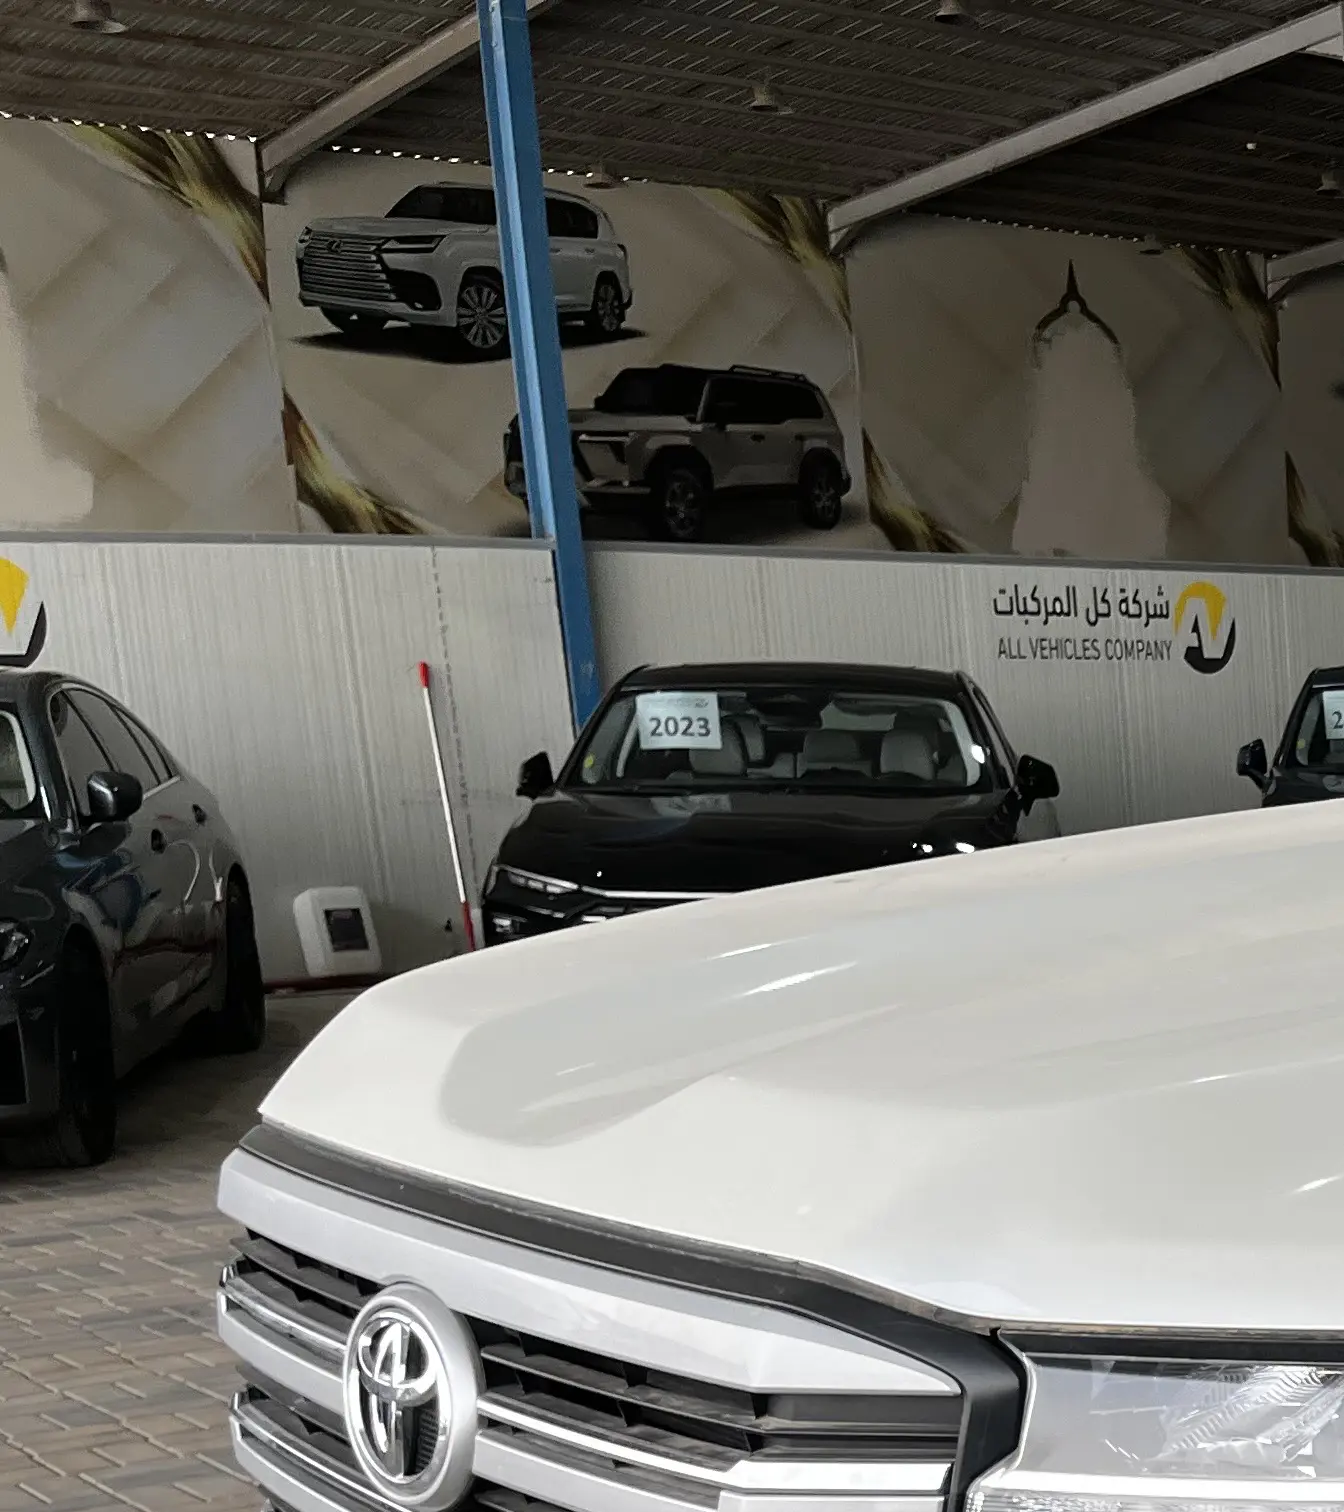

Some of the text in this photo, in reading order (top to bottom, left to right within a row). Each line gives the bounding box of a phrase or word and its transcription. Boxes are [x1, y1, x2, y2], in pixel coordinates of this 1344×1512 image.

[993, 583, 1170, 628] شركة كل المركبات
[998, 637, 1173, 661] ALL VEHICLES COMPANY
[649, 716, 712, 738] 2023
